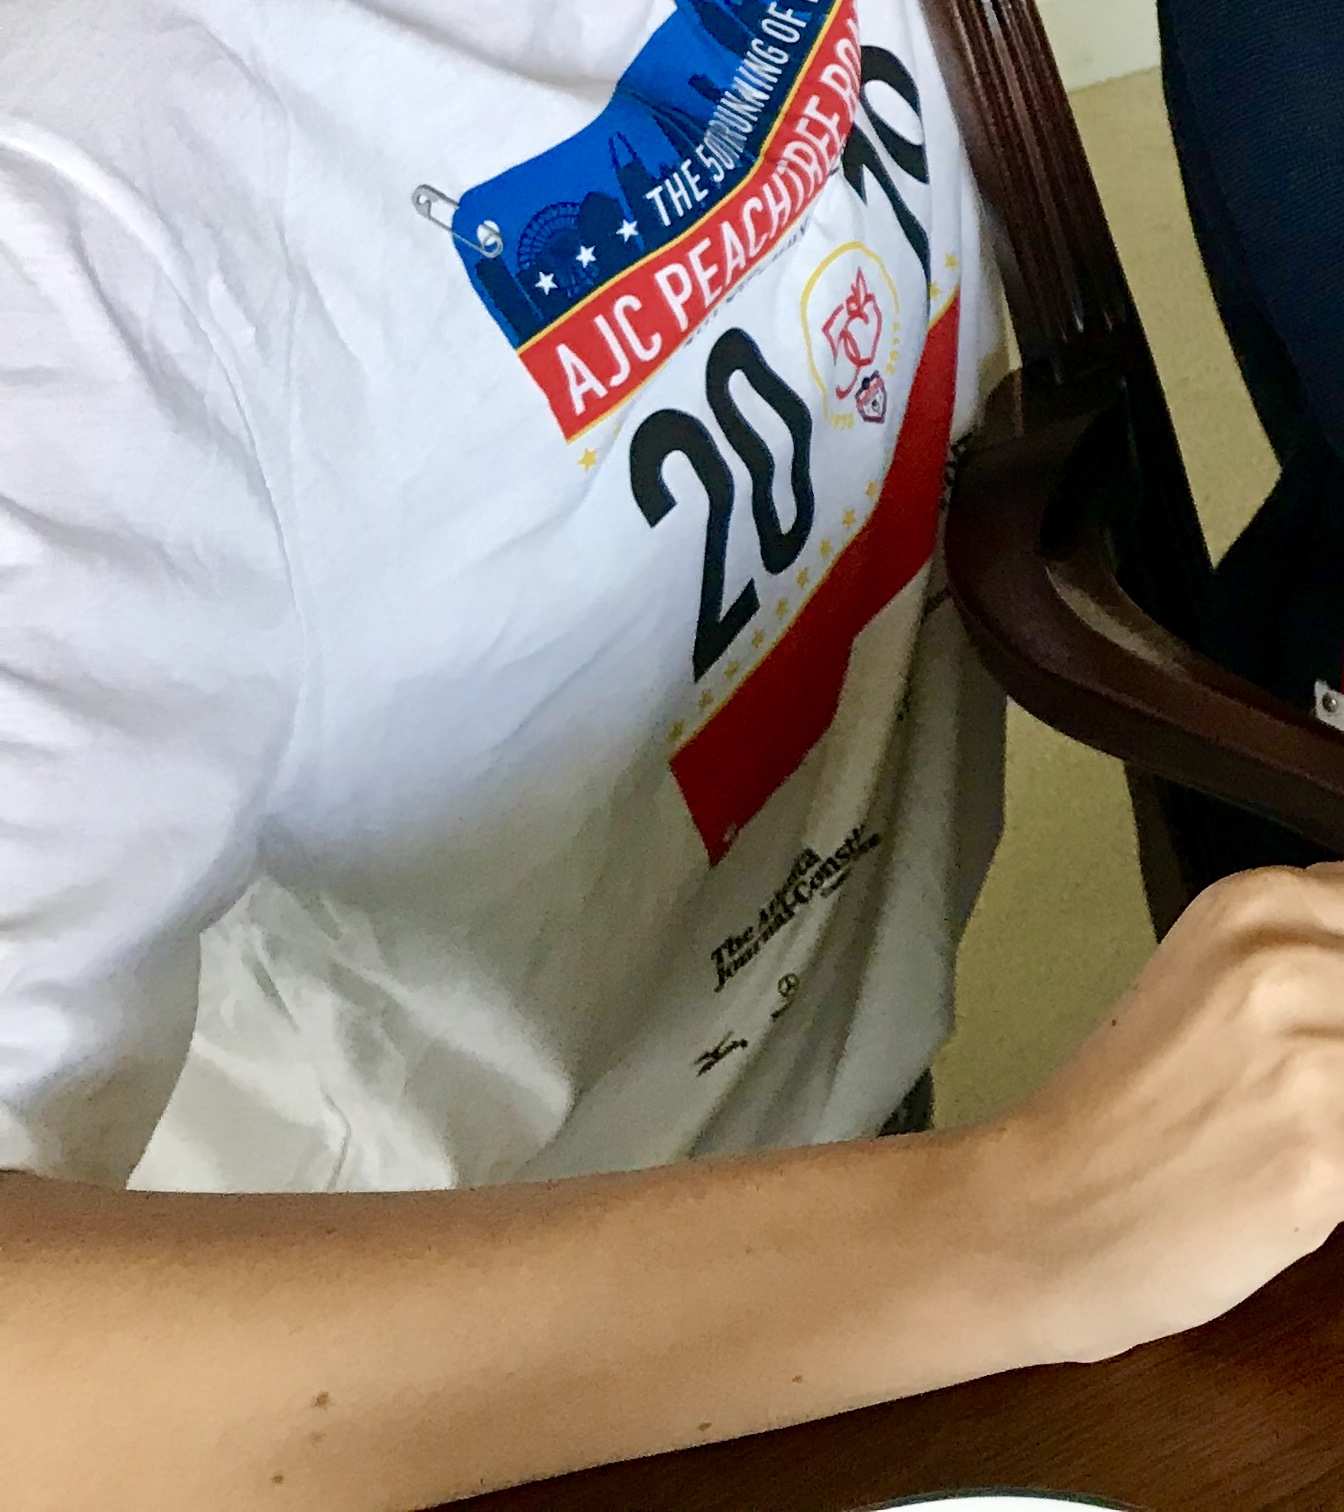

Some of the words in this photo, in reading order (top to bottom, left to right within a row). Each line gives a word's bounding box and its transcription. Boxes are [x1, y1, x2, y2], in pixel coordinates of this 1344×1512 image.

[645, 158, 709, 227] THE
[709, 37, 790, 154] RUNNING
[762, 4, 815, 46] OF
[555, 293, 663, 416] AJC
[654, 93, 844, 328] PEACHTREE
[629, 327, 814, 683] 20
[710, 926, 754, 962] The
